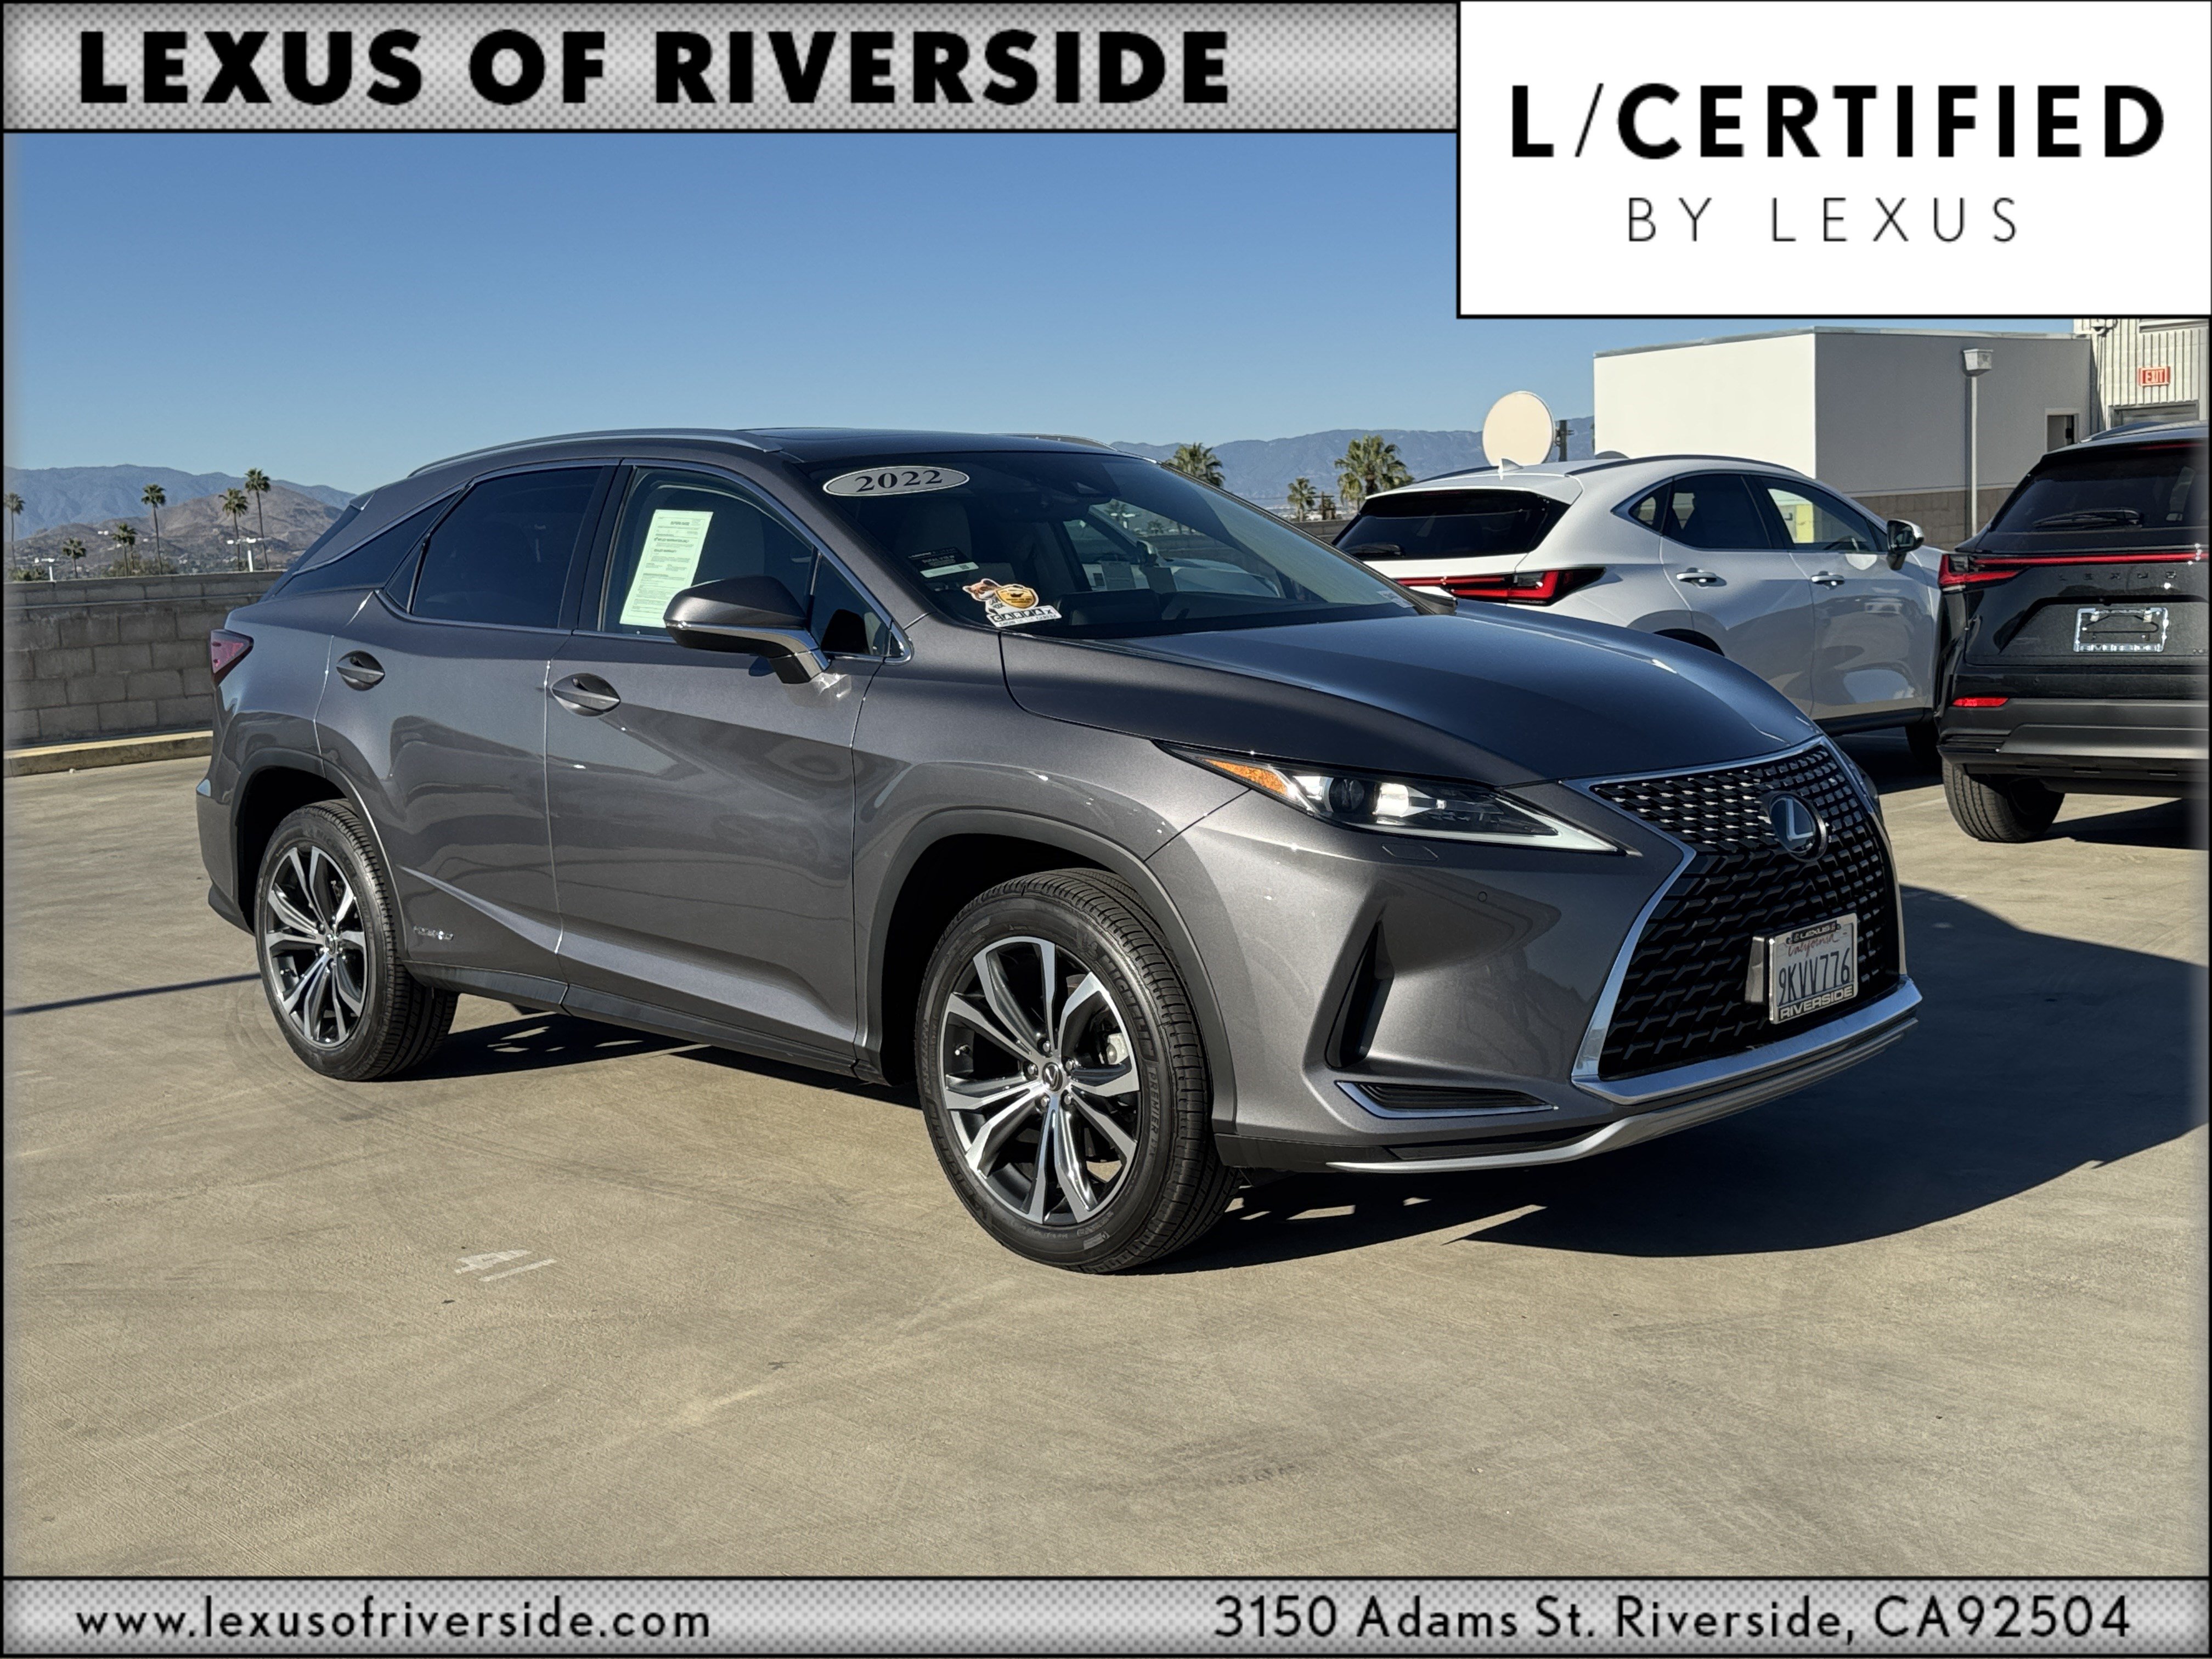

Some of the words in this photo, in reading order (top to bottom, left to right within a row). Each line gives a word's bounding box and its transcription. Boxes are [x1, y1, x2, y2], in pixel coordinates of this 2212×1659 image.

[2145, 369, 2164, 383] EXIT
[854, 470, 944, 493] 2022
[991, 608, 1053, 623] CARFAX
[1800, 926, 1830, 938] LEXUS
[1787, 933, 1840, 957] California
[1778, 947, 1850, 1006] 9KVV776
[1097, 953, 1159, 1062] MICHELIN
[1780, 985, 1853, 1020] RIVERSIDE
